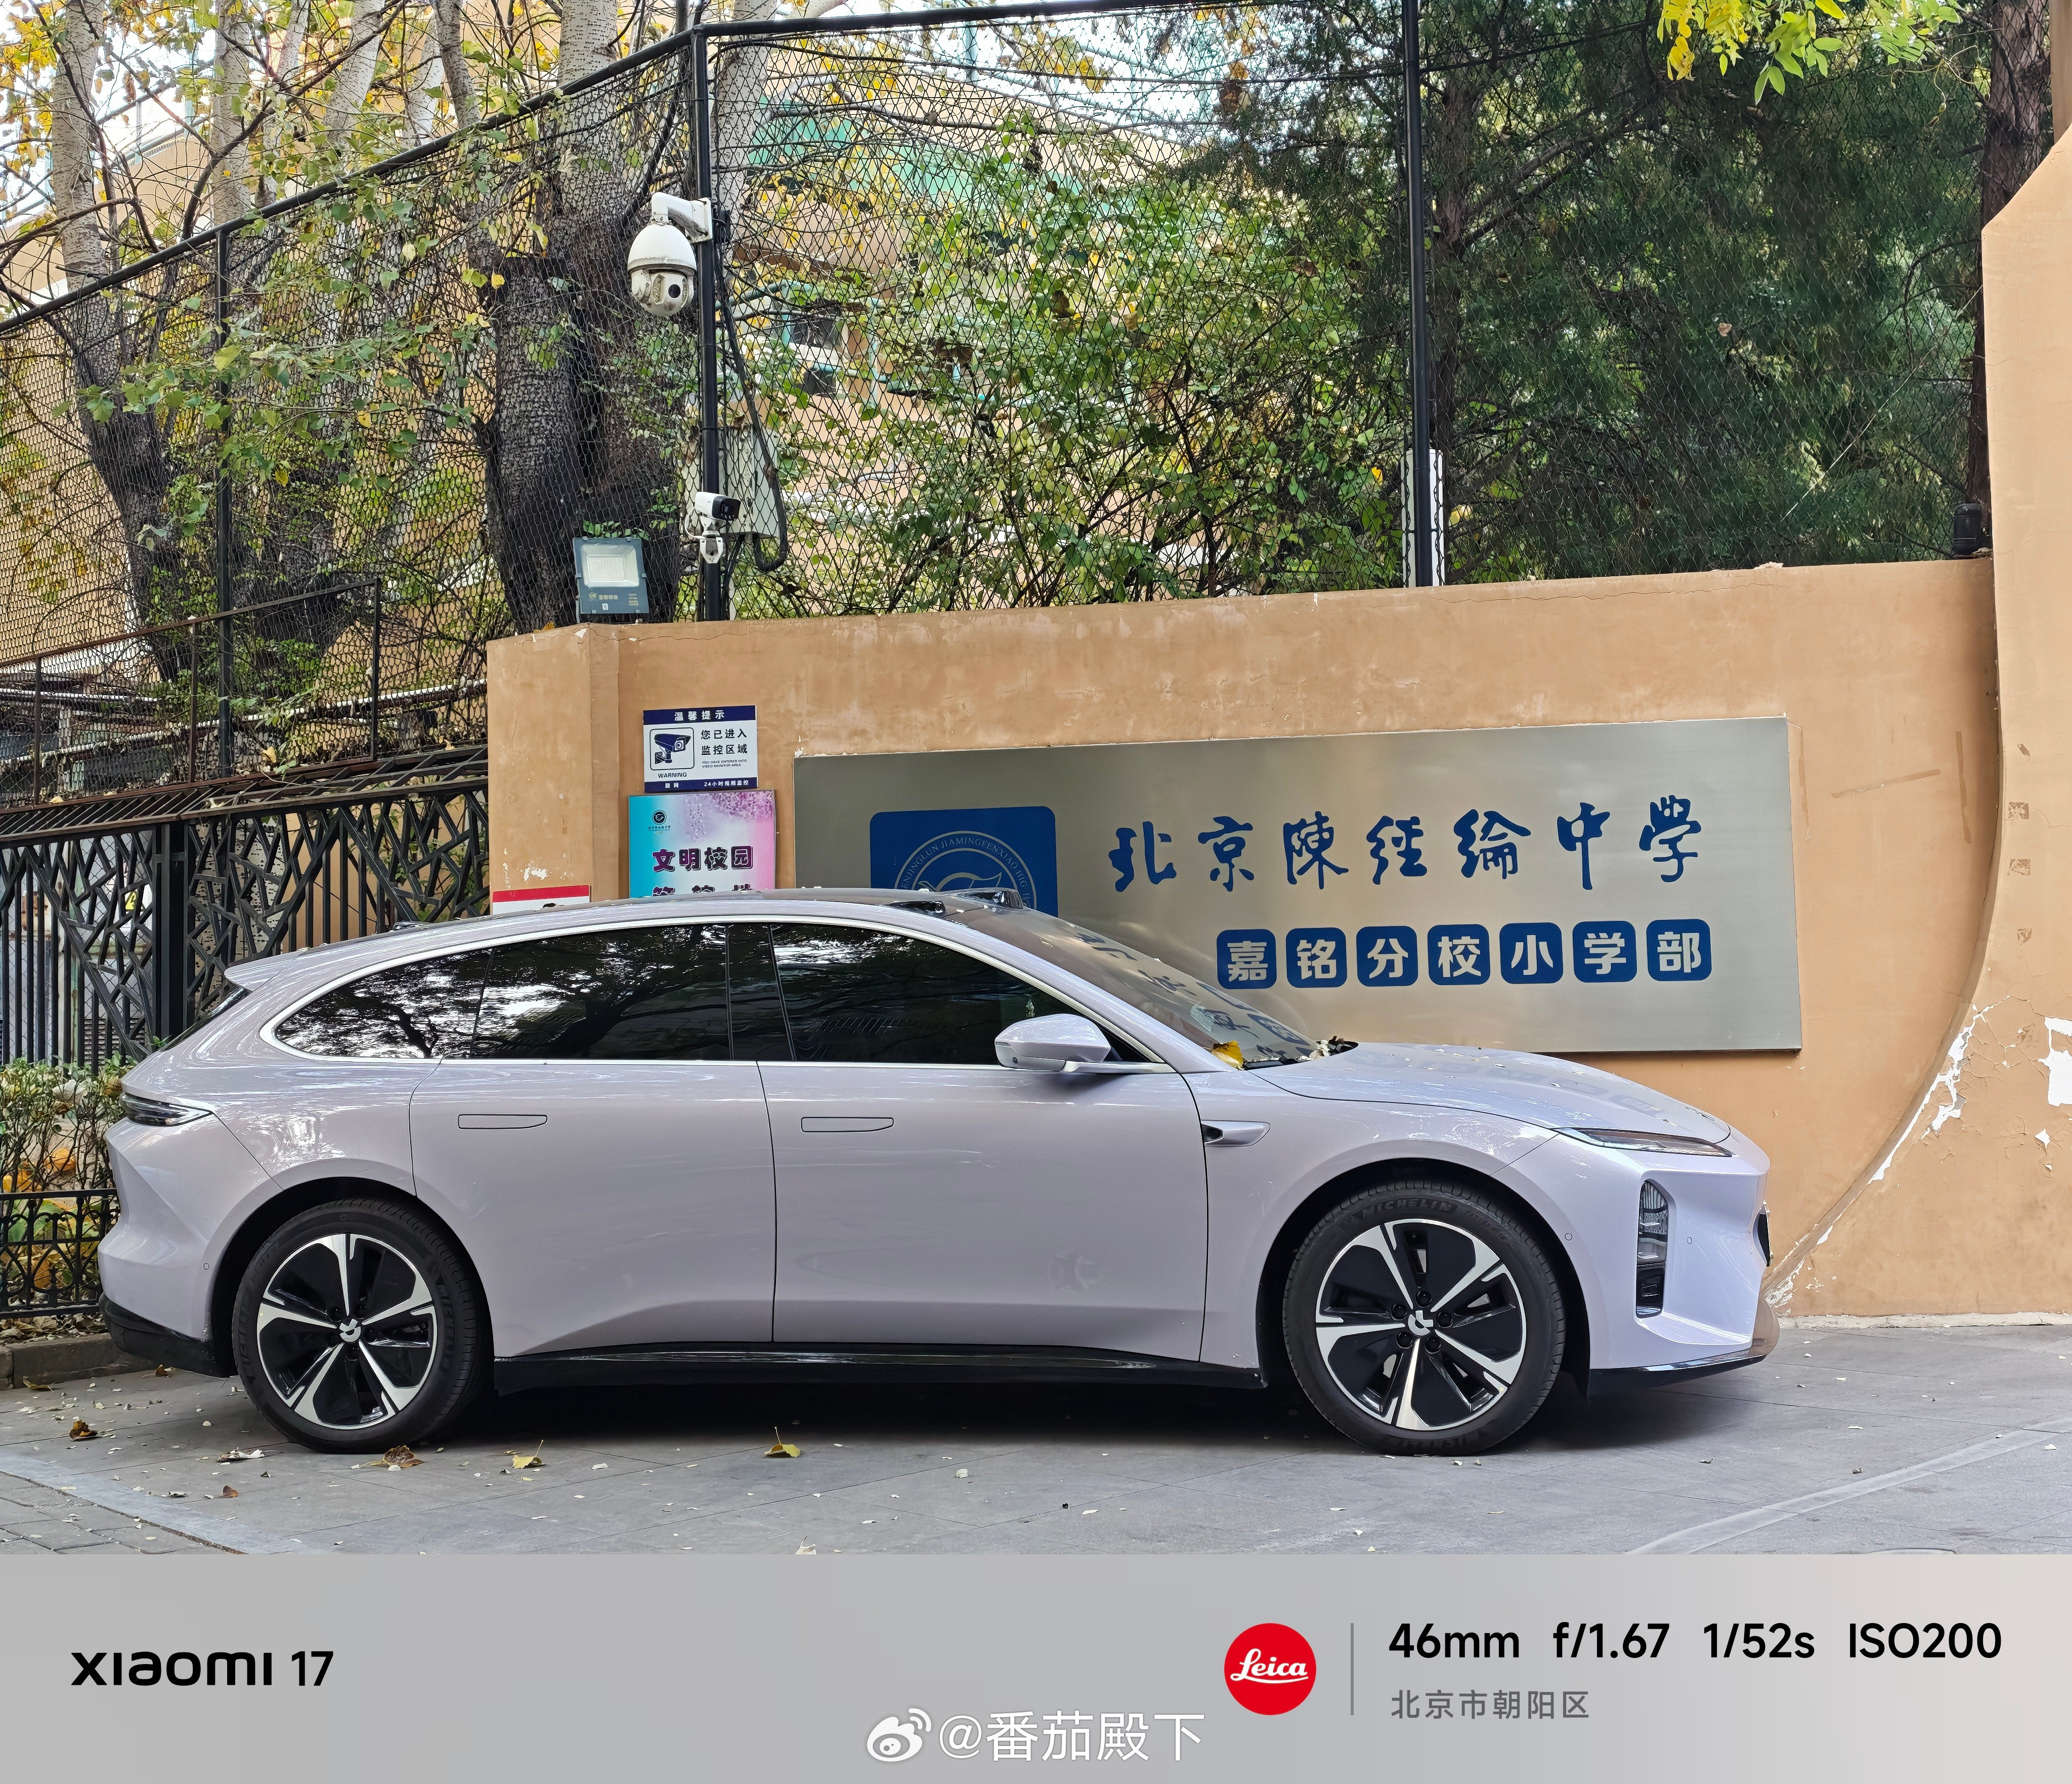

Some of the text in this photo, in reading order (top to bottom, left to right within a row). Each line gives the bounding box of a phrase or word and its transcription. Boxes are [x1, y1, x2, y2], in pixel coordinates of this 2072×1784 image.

[674, 710, 725, 721] 温馨提示
[701, 729, 747, 740] 您已进入
[701, 744, 748, 755] 监控区域
[652, 845, 753, 873] 文明校园
[901, 844, 939, 889] ENJINGLUN
[1227, 931, 1702, 983] 嘉铭分校小学部
